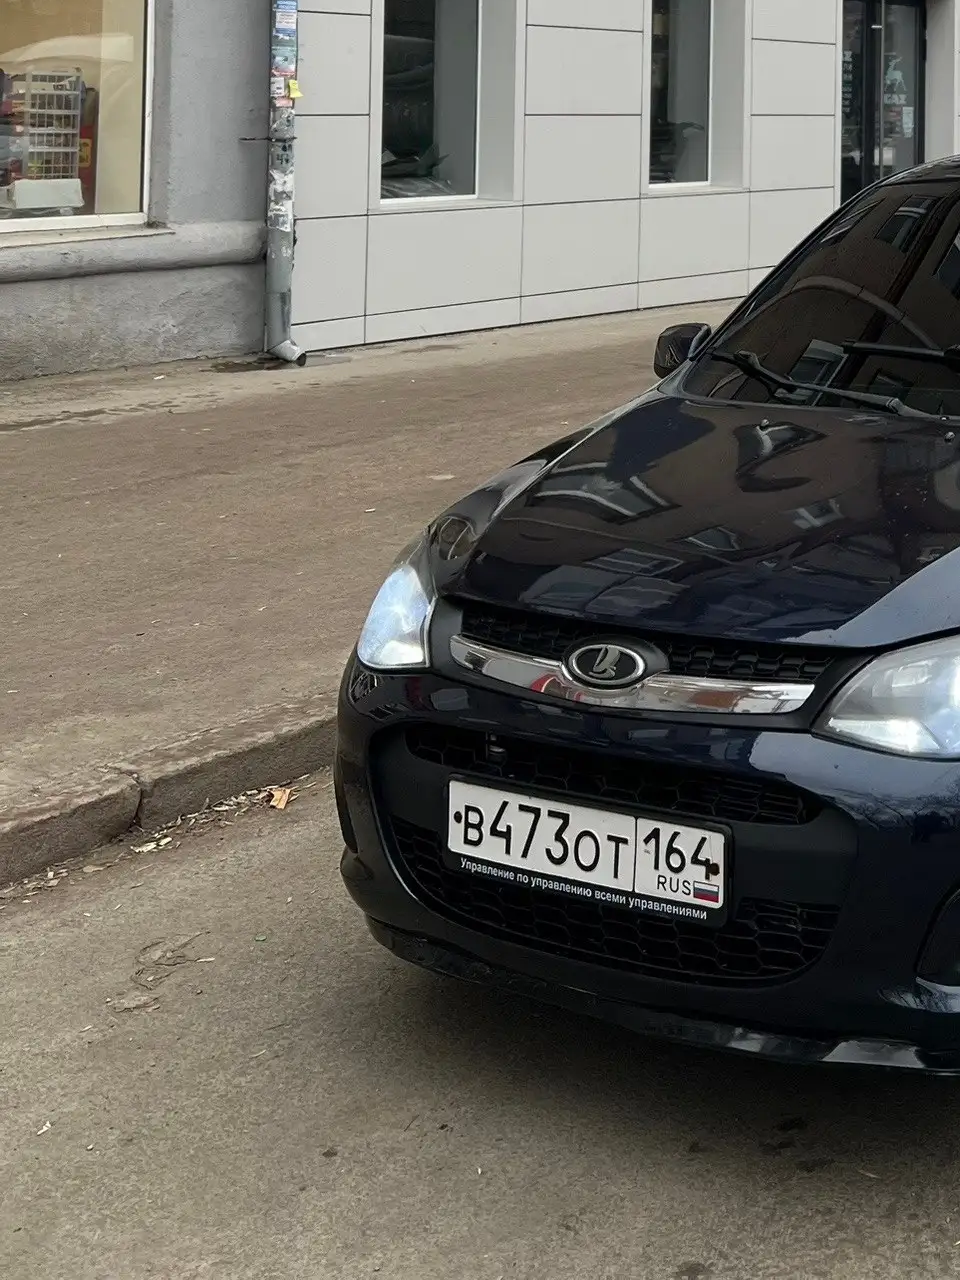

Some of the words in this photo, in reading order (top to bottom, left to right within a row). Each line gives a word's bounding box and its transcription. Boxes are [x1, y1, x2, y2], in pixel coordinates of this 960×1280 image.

[463, 800, 629, 880] В473ОТ
[642, 827, 712, 881] 164
[460, 857, 514, 882] Управление
[516, 872, 529, 884] по
[530, 876, 592, 898] управлению
[594, 889, 626, 905] всеми
[628, 896, 708, 920] управлениями
[656, 874, 692, 896] RUS
